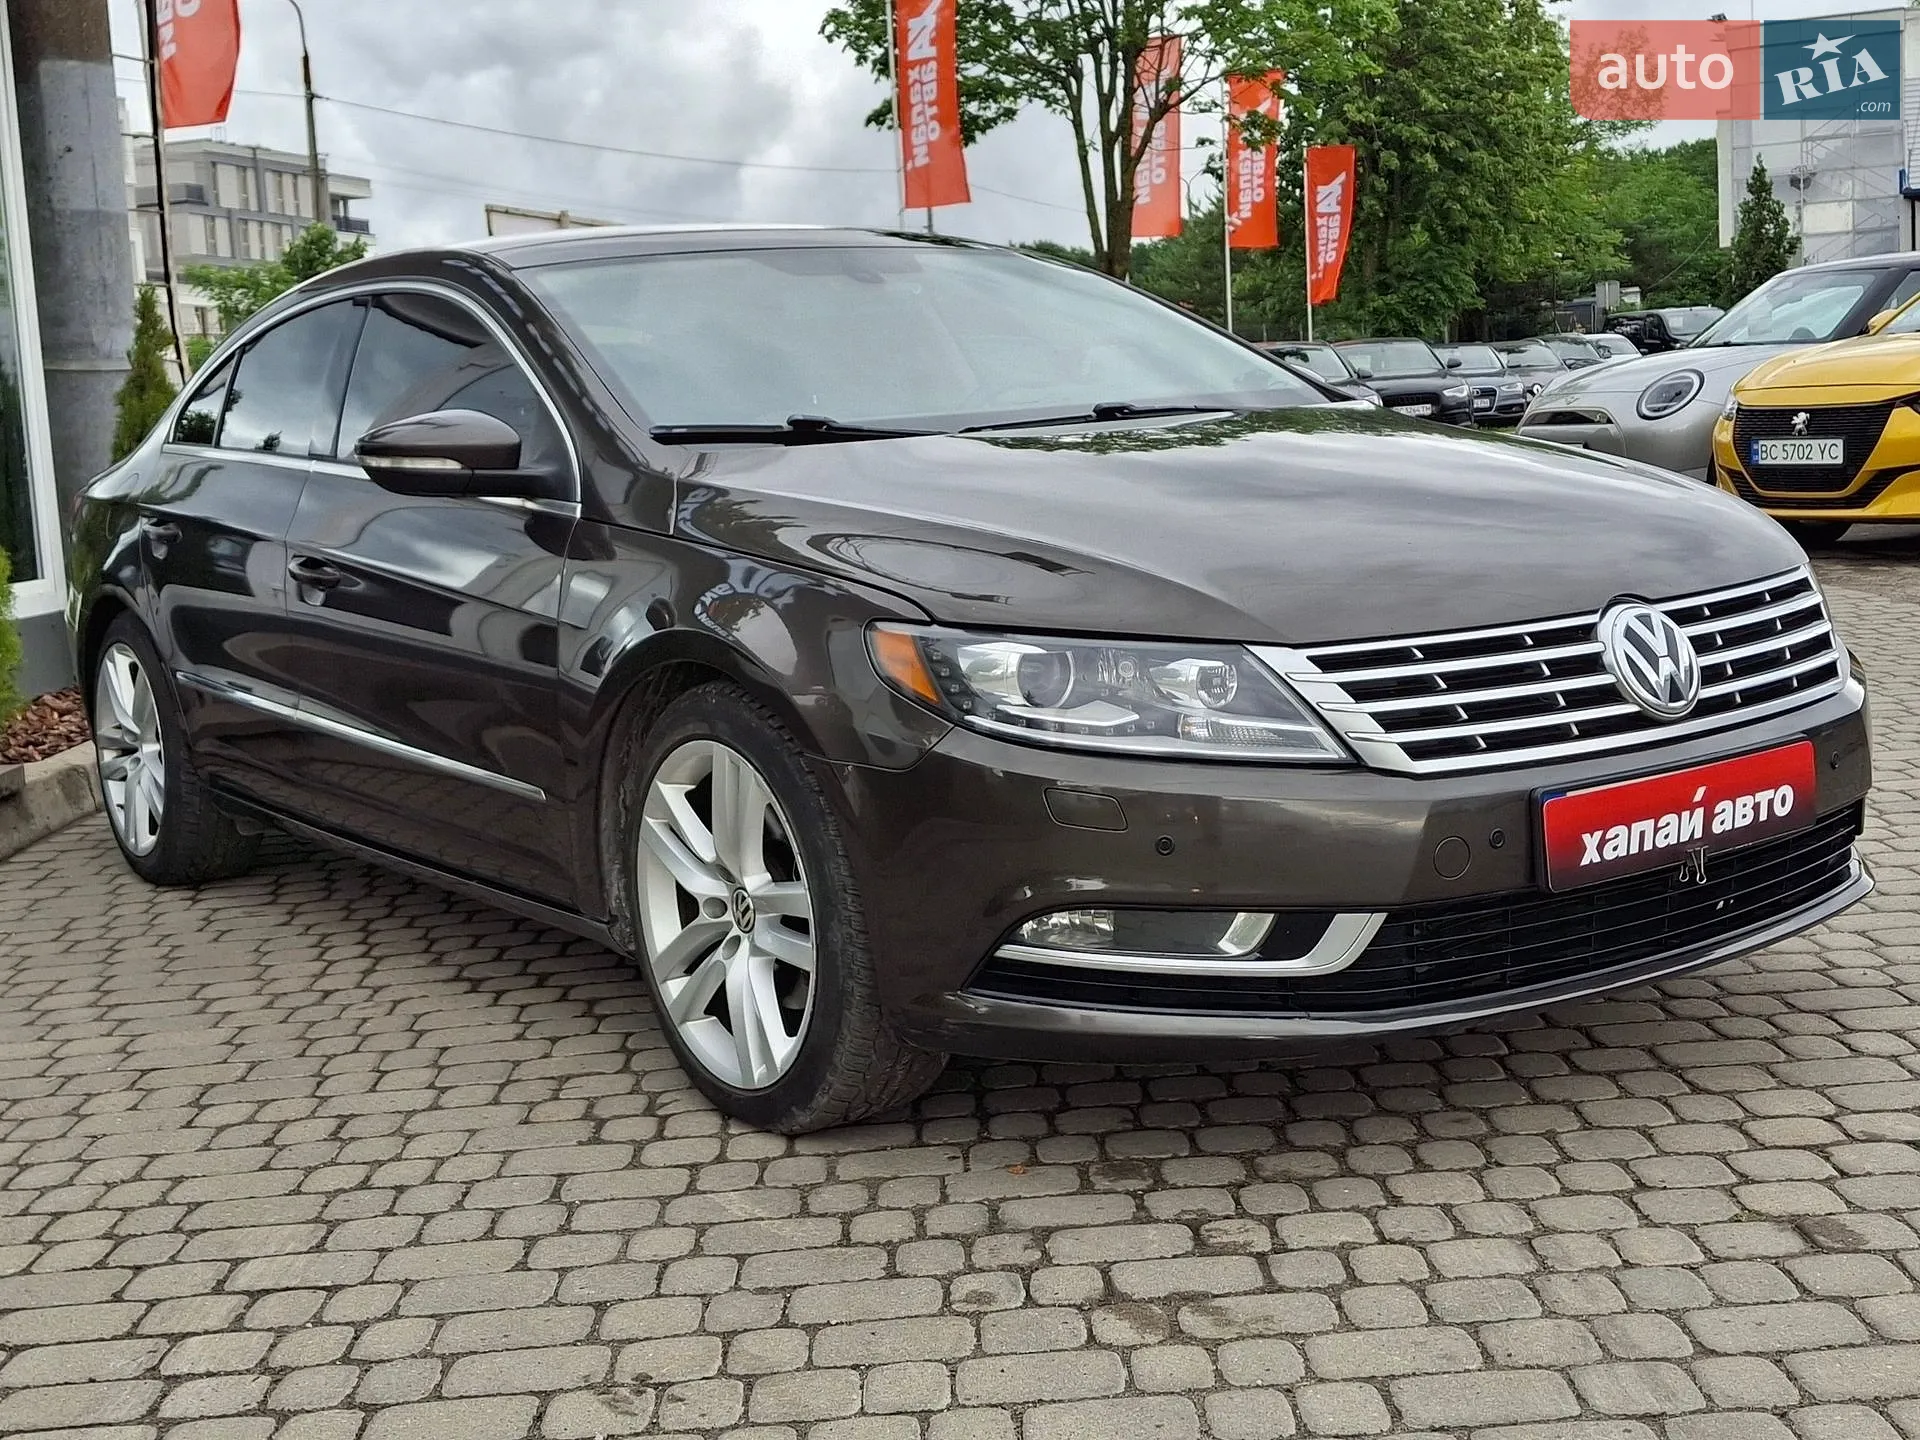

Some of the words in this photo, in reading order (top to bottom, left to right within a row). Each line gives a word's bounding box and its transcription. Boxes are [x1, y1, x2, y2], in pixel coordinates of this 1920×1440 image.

[1760, 443, 1778, 461] BC
[1782, 443, 1813, 461] 5702
[1818, 443, 1839, 460] YC
[1711, 784, 1795, 834] авто
